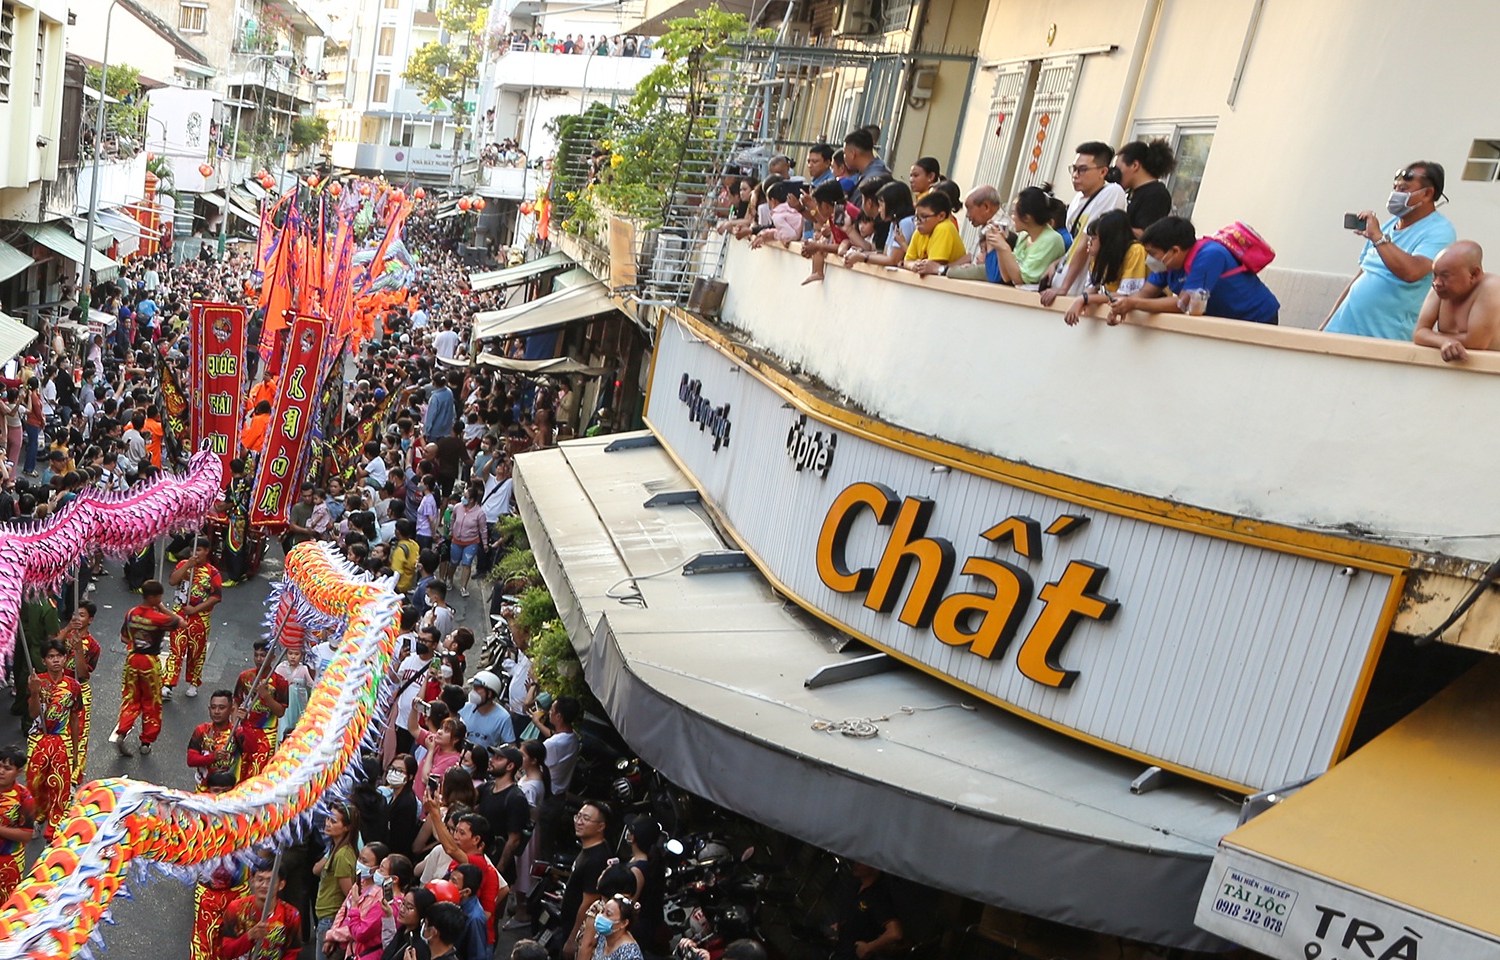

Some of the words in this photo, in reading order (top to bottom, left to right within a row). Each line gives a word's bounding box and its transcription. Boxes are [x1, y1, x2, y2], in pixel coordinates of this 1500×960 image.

[815, 481, 1121, 690] Chất
[1215, 898, 1241, 917] 0918
[1242, 907, 1262, 925] 212
[1263, 915, 1283, 933] 078
[1223, 883, 1252, 903] TÀI
[1255, 894, 1287, 916] LỘC
